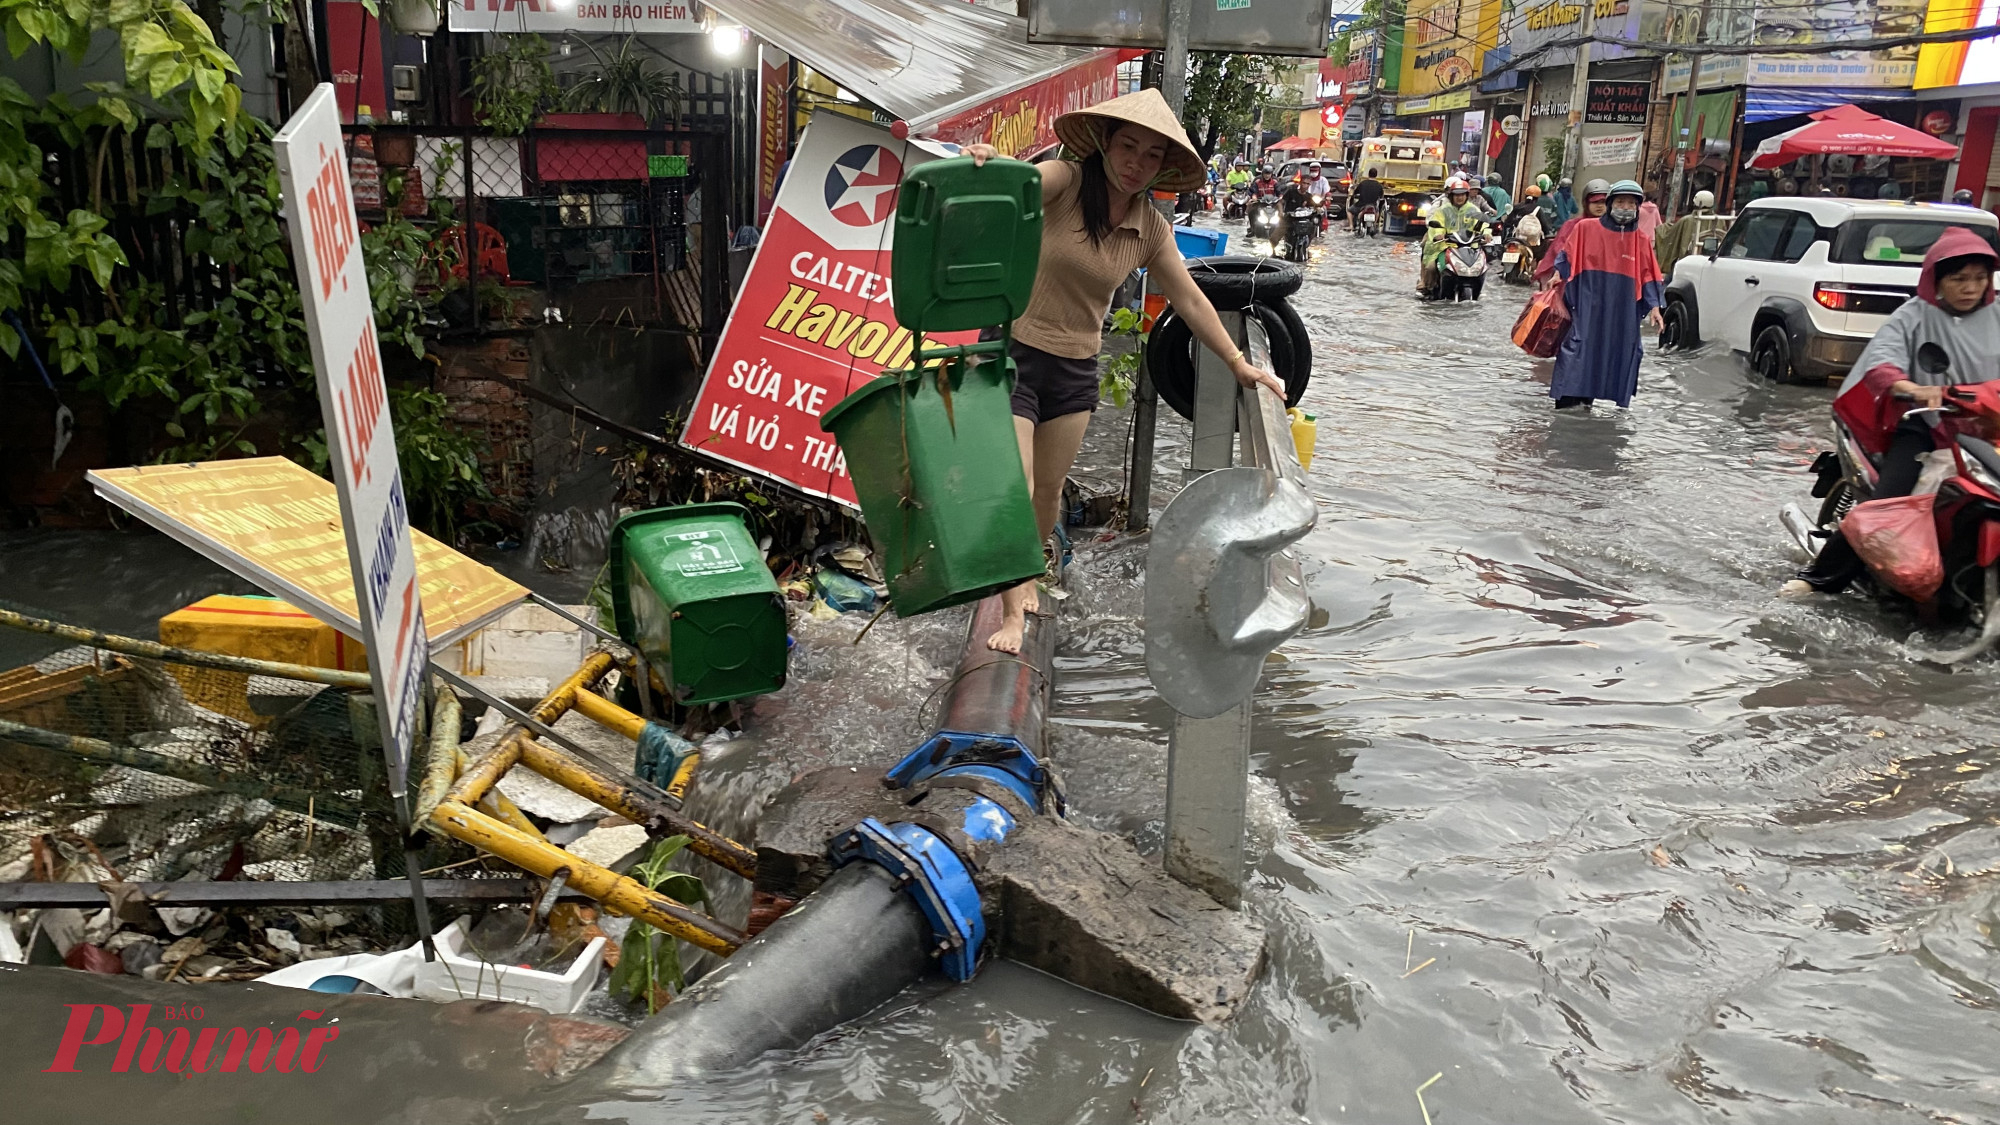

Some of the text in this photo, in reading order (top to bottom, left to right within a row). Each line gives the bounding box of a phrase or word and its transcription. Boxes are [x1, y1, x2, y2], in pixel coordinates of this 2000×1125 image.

[577, 1, 606, 18] BÁN
[648, 0, 685, 19] HIỂM
[306, 142, 354, 302] ĐIỆN
[339, 315, 384, 491] LẠNH
[727, 358, 827, 416] SỬA XE
[709, 402, 743, 438] VÁ
[746, 414, 780, 451] VỎ
[801, 435, 853, 480] THA
